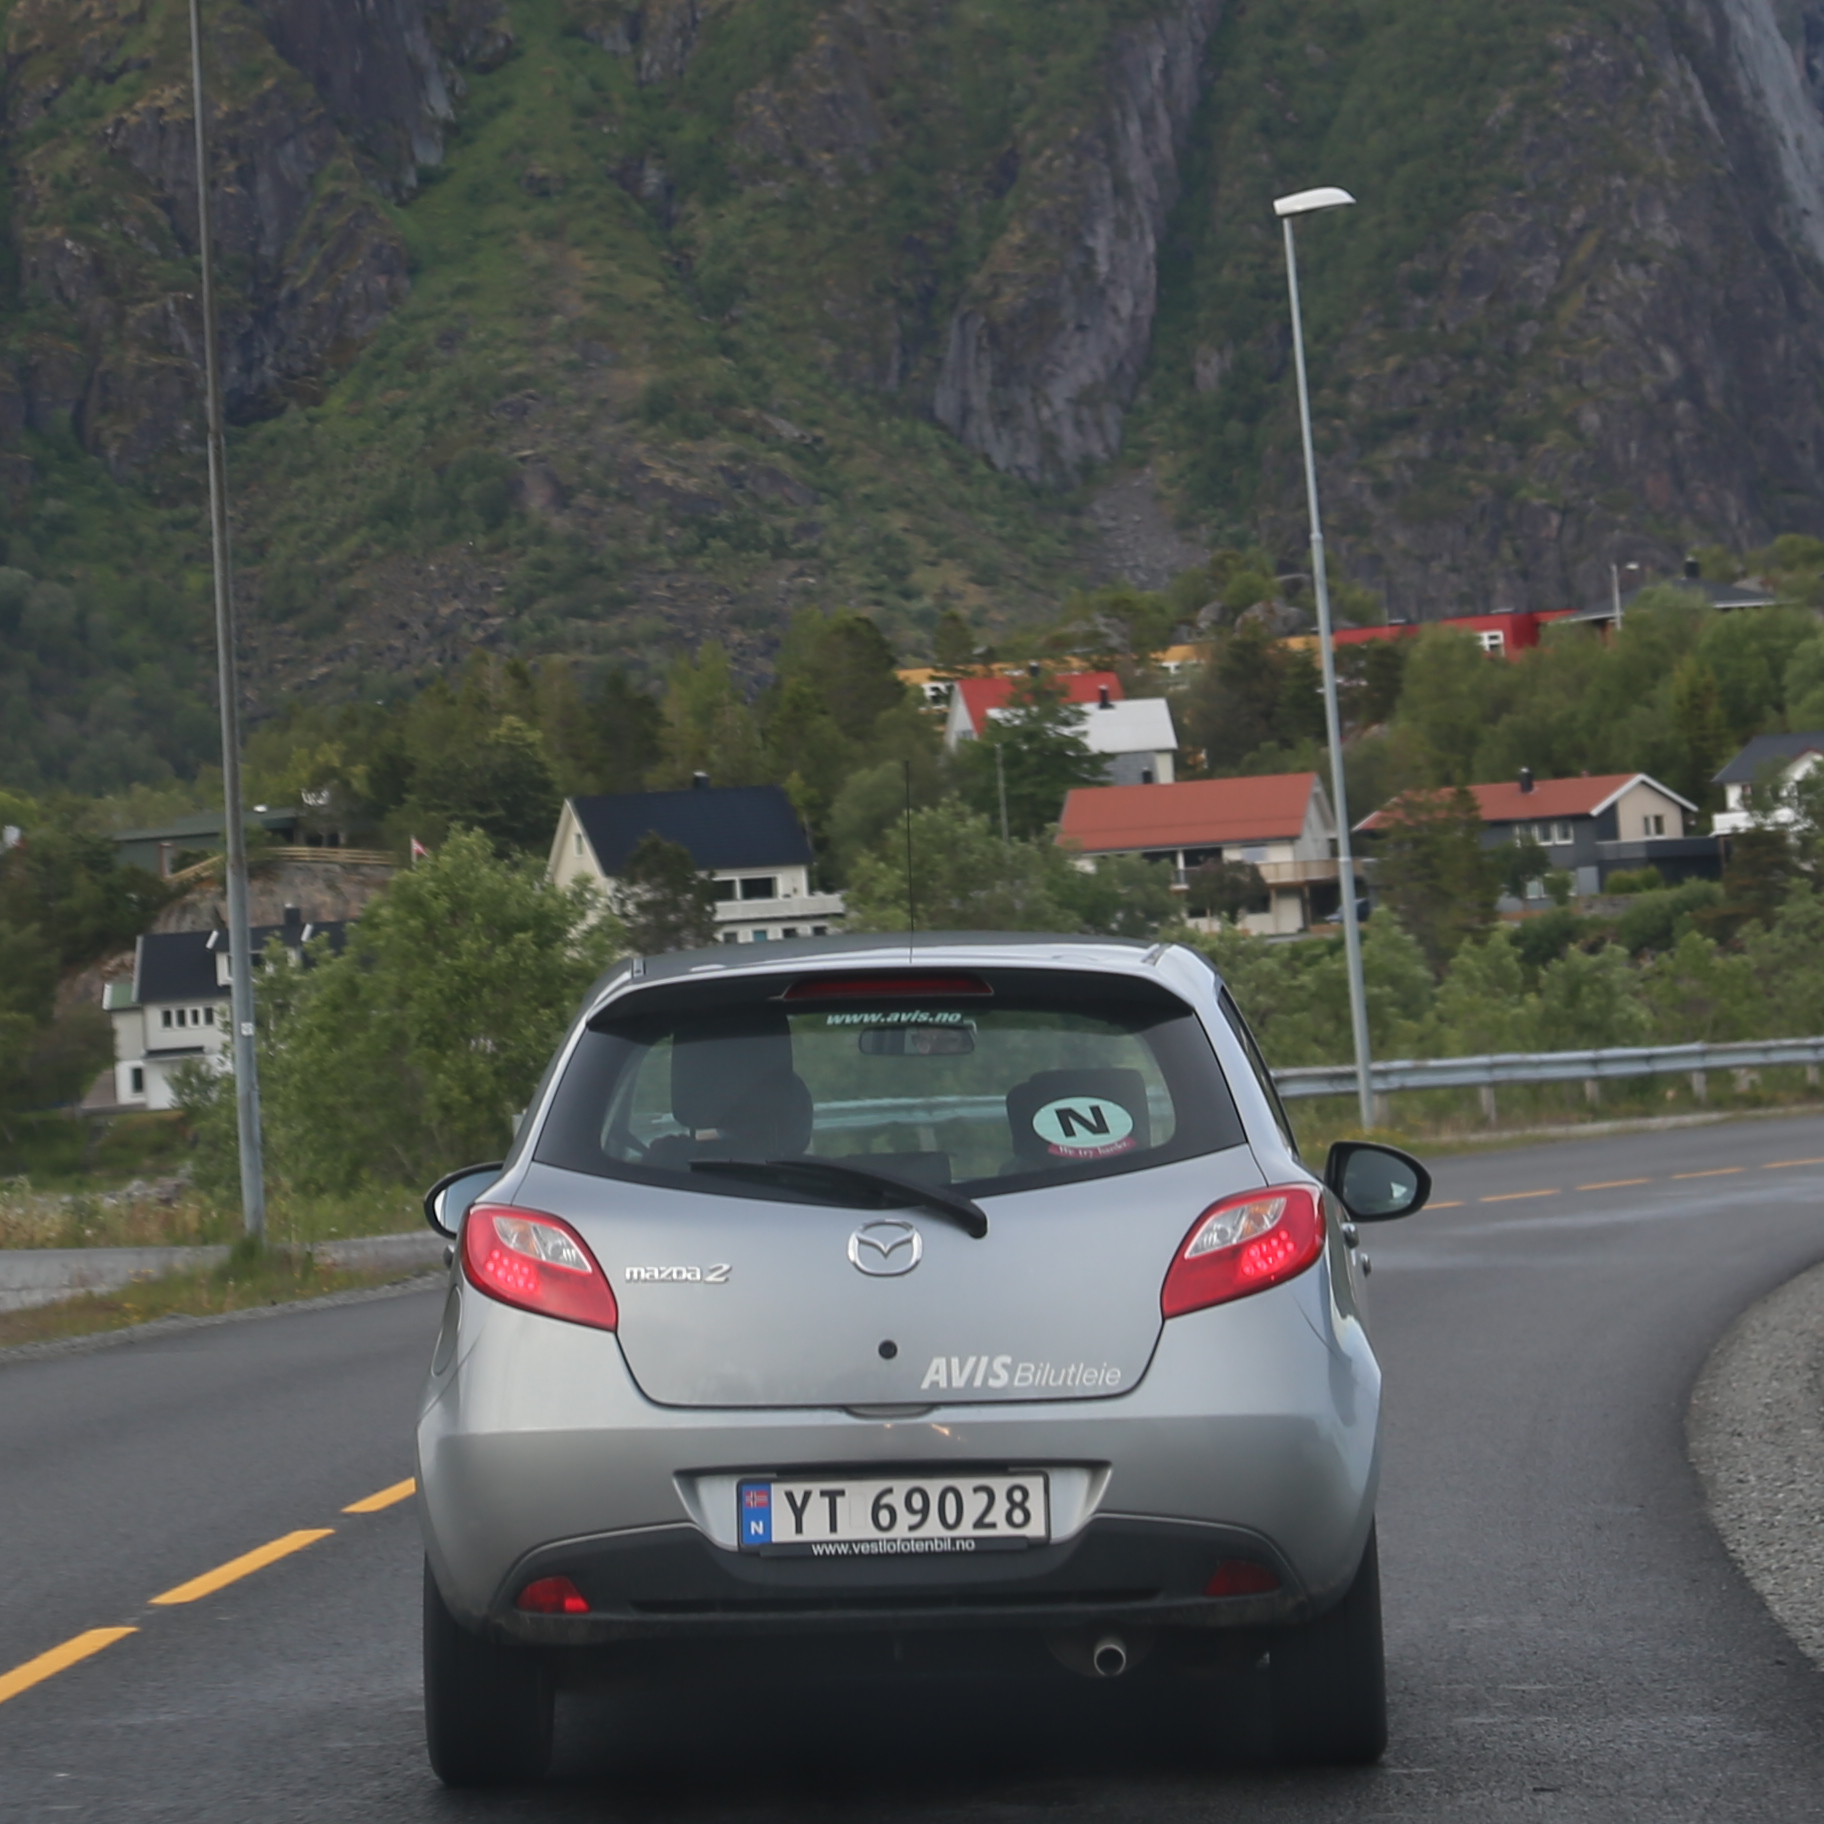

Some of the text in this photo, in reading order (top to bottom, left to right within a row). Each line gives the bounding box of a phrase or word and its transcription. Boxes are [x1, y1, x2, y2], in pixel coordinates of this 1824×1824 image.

[826, 1010, 962, 1026] www.avis.no
[1054, 1104, 1111, 1138] N
[704, 1262, 732, 1284] 2
[920, 1354, 1122, 1390] AVIS Bilutleie
[784, 1483, 1032, 1536] YT 69028
[750, 1520, 764, 1536] N
[811, 1537, 976, 1556] www.vestlofotenbil.no
